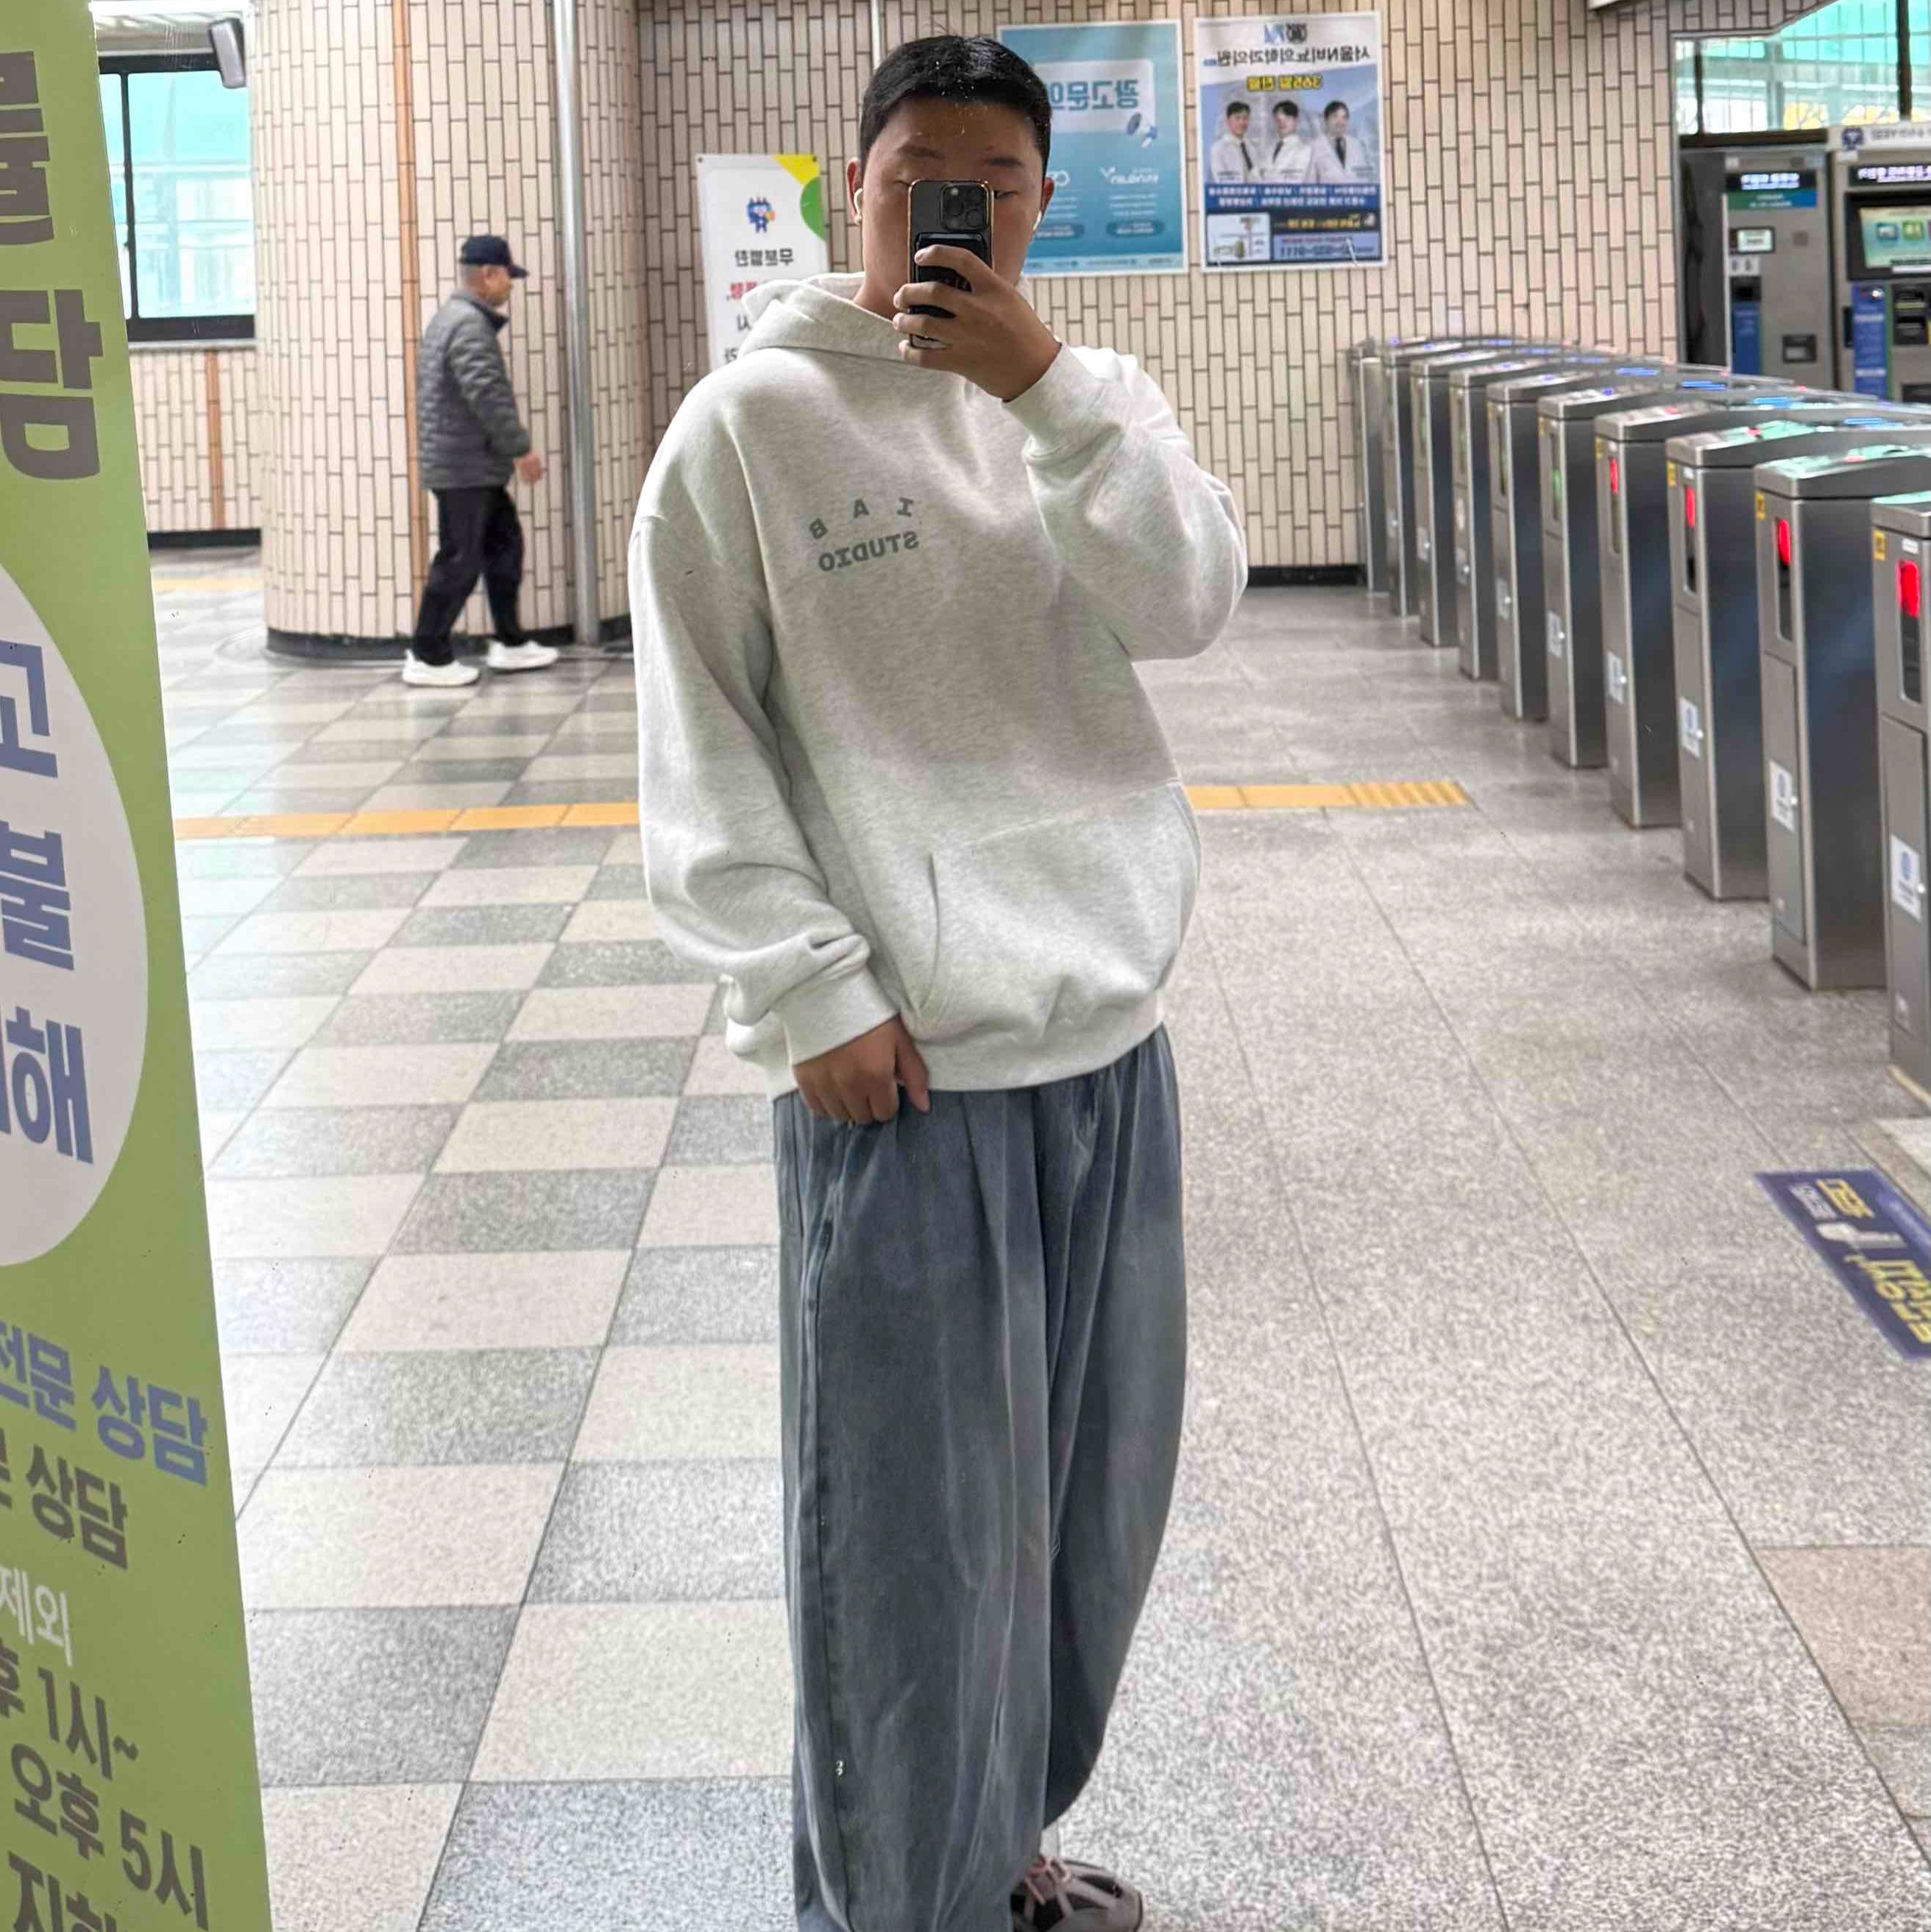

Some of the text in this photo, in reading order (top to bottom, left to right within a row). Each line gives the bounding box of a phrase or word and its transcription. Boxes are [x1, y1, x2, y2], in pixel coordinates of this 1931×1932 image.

[0, 1004, 93, 1164] 해
[91, 1365, 208, 1485] 상담
[26, 1444, 128, 1569] 상담
[38, 1666, 139, 1781] 1시~
[11, 1742, 209, 1932] 오후 5시
